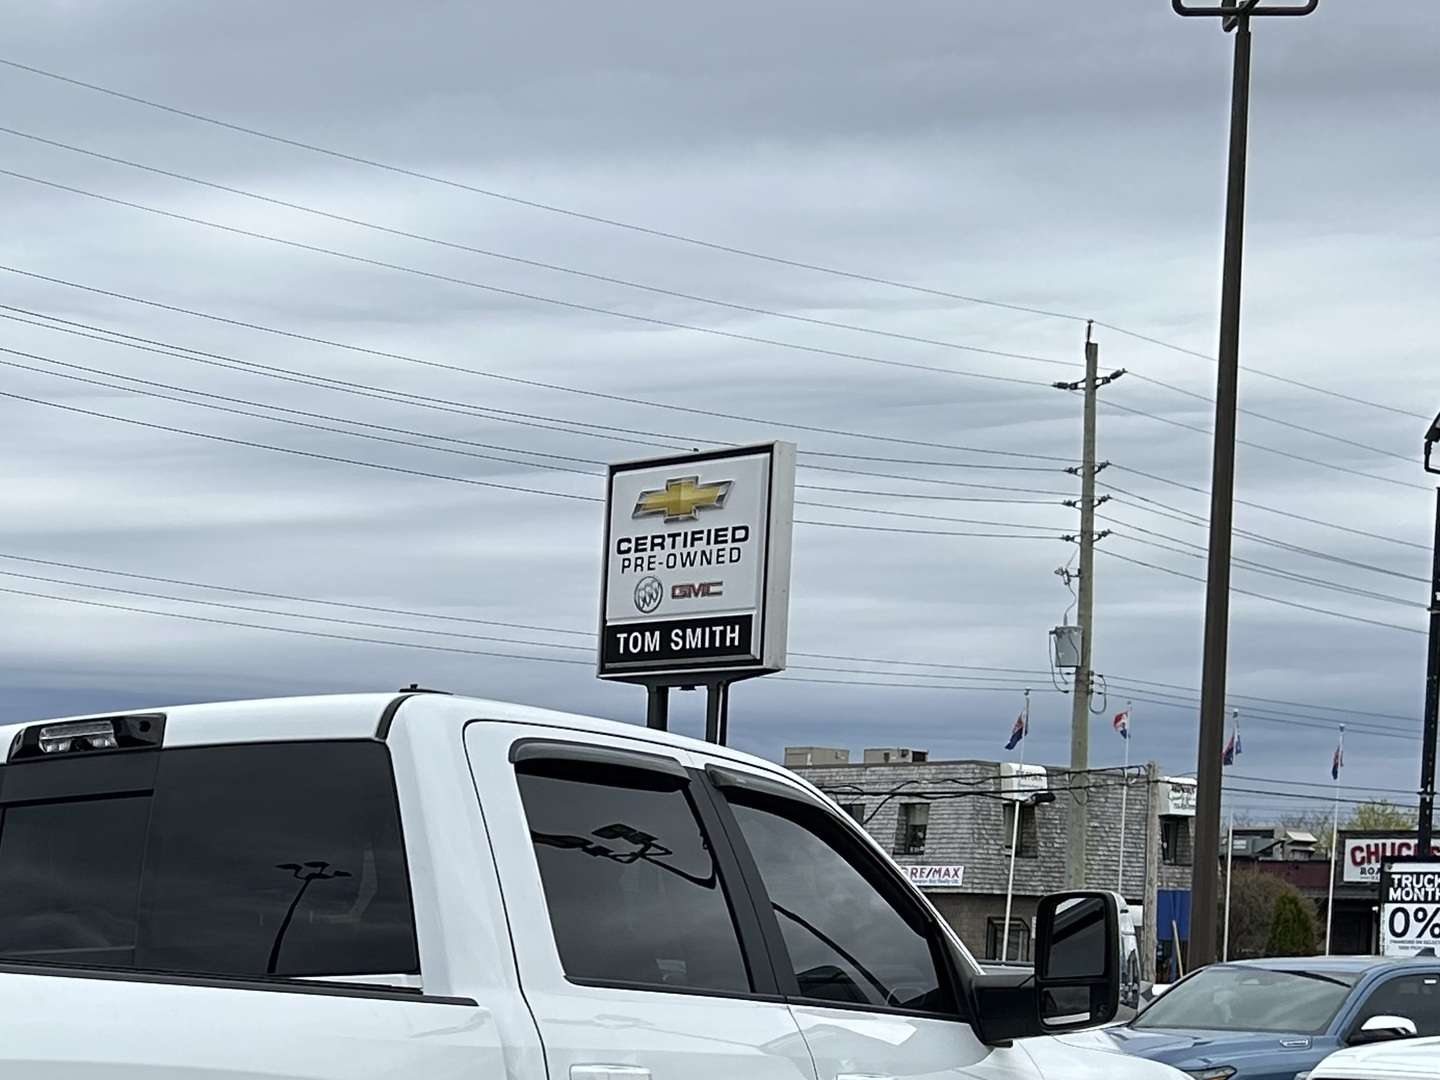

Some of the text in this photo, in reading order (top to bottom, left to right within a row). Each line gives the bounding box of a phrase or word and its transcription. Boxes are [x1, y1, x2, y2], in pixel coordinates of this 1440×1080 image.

[616, 525, 750, 555] CERTIFIED
[621, 547, 742, 574] PRE-OWNED
[671, 581, 723, 600] GMC
[616, 625, 740, 654] TOM SMITH
[911, 867, 960, 879] RE/MAX
